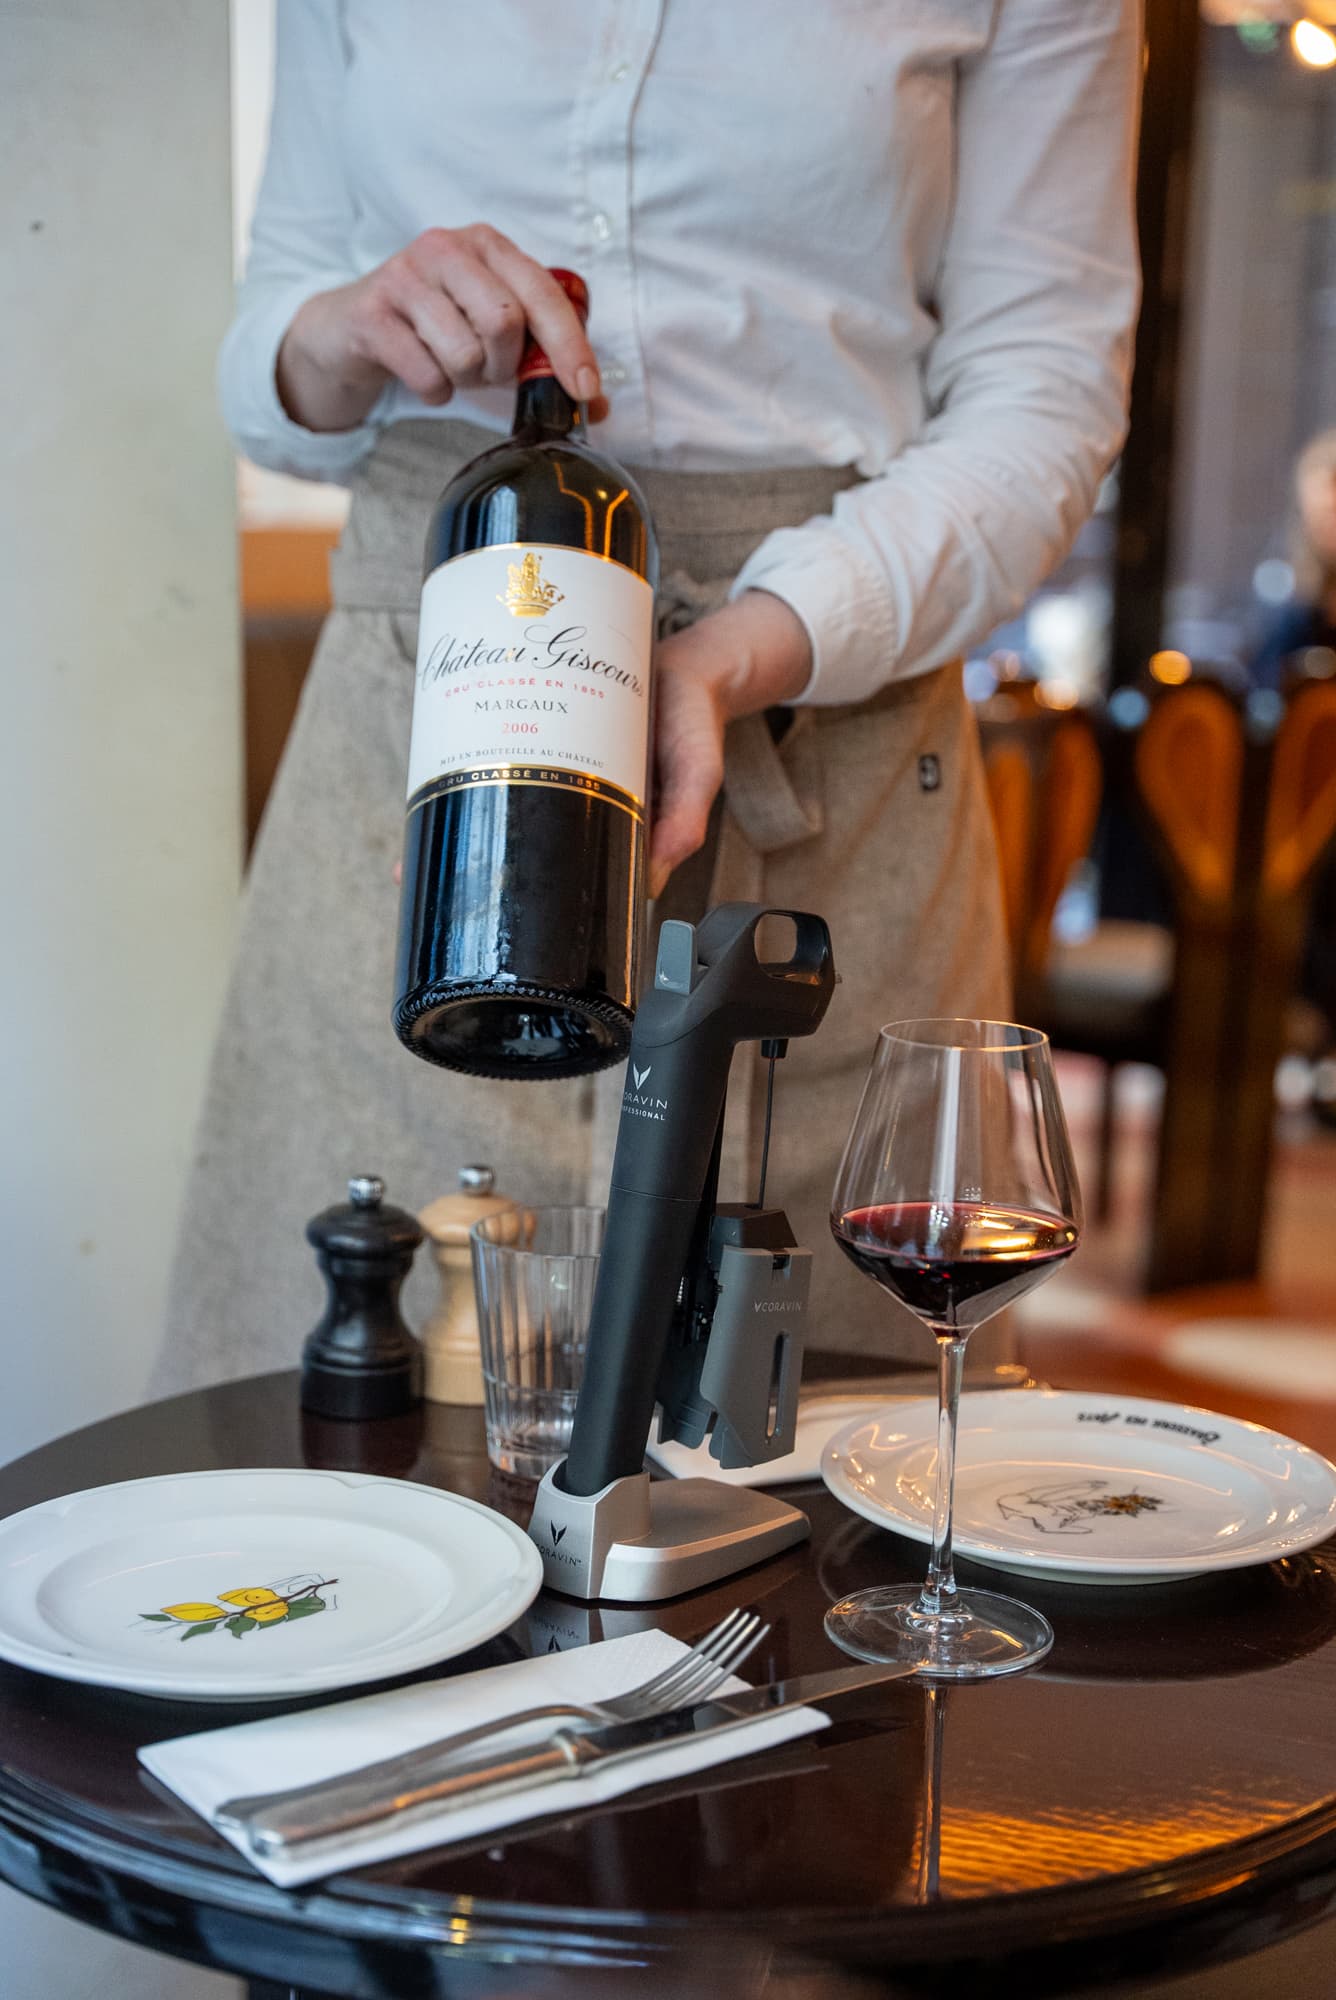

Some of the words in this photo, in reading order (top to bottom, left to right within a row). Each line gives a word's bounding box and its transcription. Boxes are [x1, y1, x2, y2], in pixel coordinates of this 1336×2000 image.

[445, 684, 470, 698] CRU
[545, 679, 563, 688] EN
[573, 683, 605, 698] 1855
[474, 698, 569, 714] MARGAUX
[502, 723, 539, 734] 2006
[440, 757, 456, 767] MIS
[459, 751, 472, 760] EN
[475, 747, 536, 757] BOUTEILLE
[540, 748, 554, 757] AU
[439, 776, 464, 789] CRU
[540, 771, 559, 781] EN
[569, 776, 600, 791] 1855
[623, 1091, 668, 1110] ORAVIN
